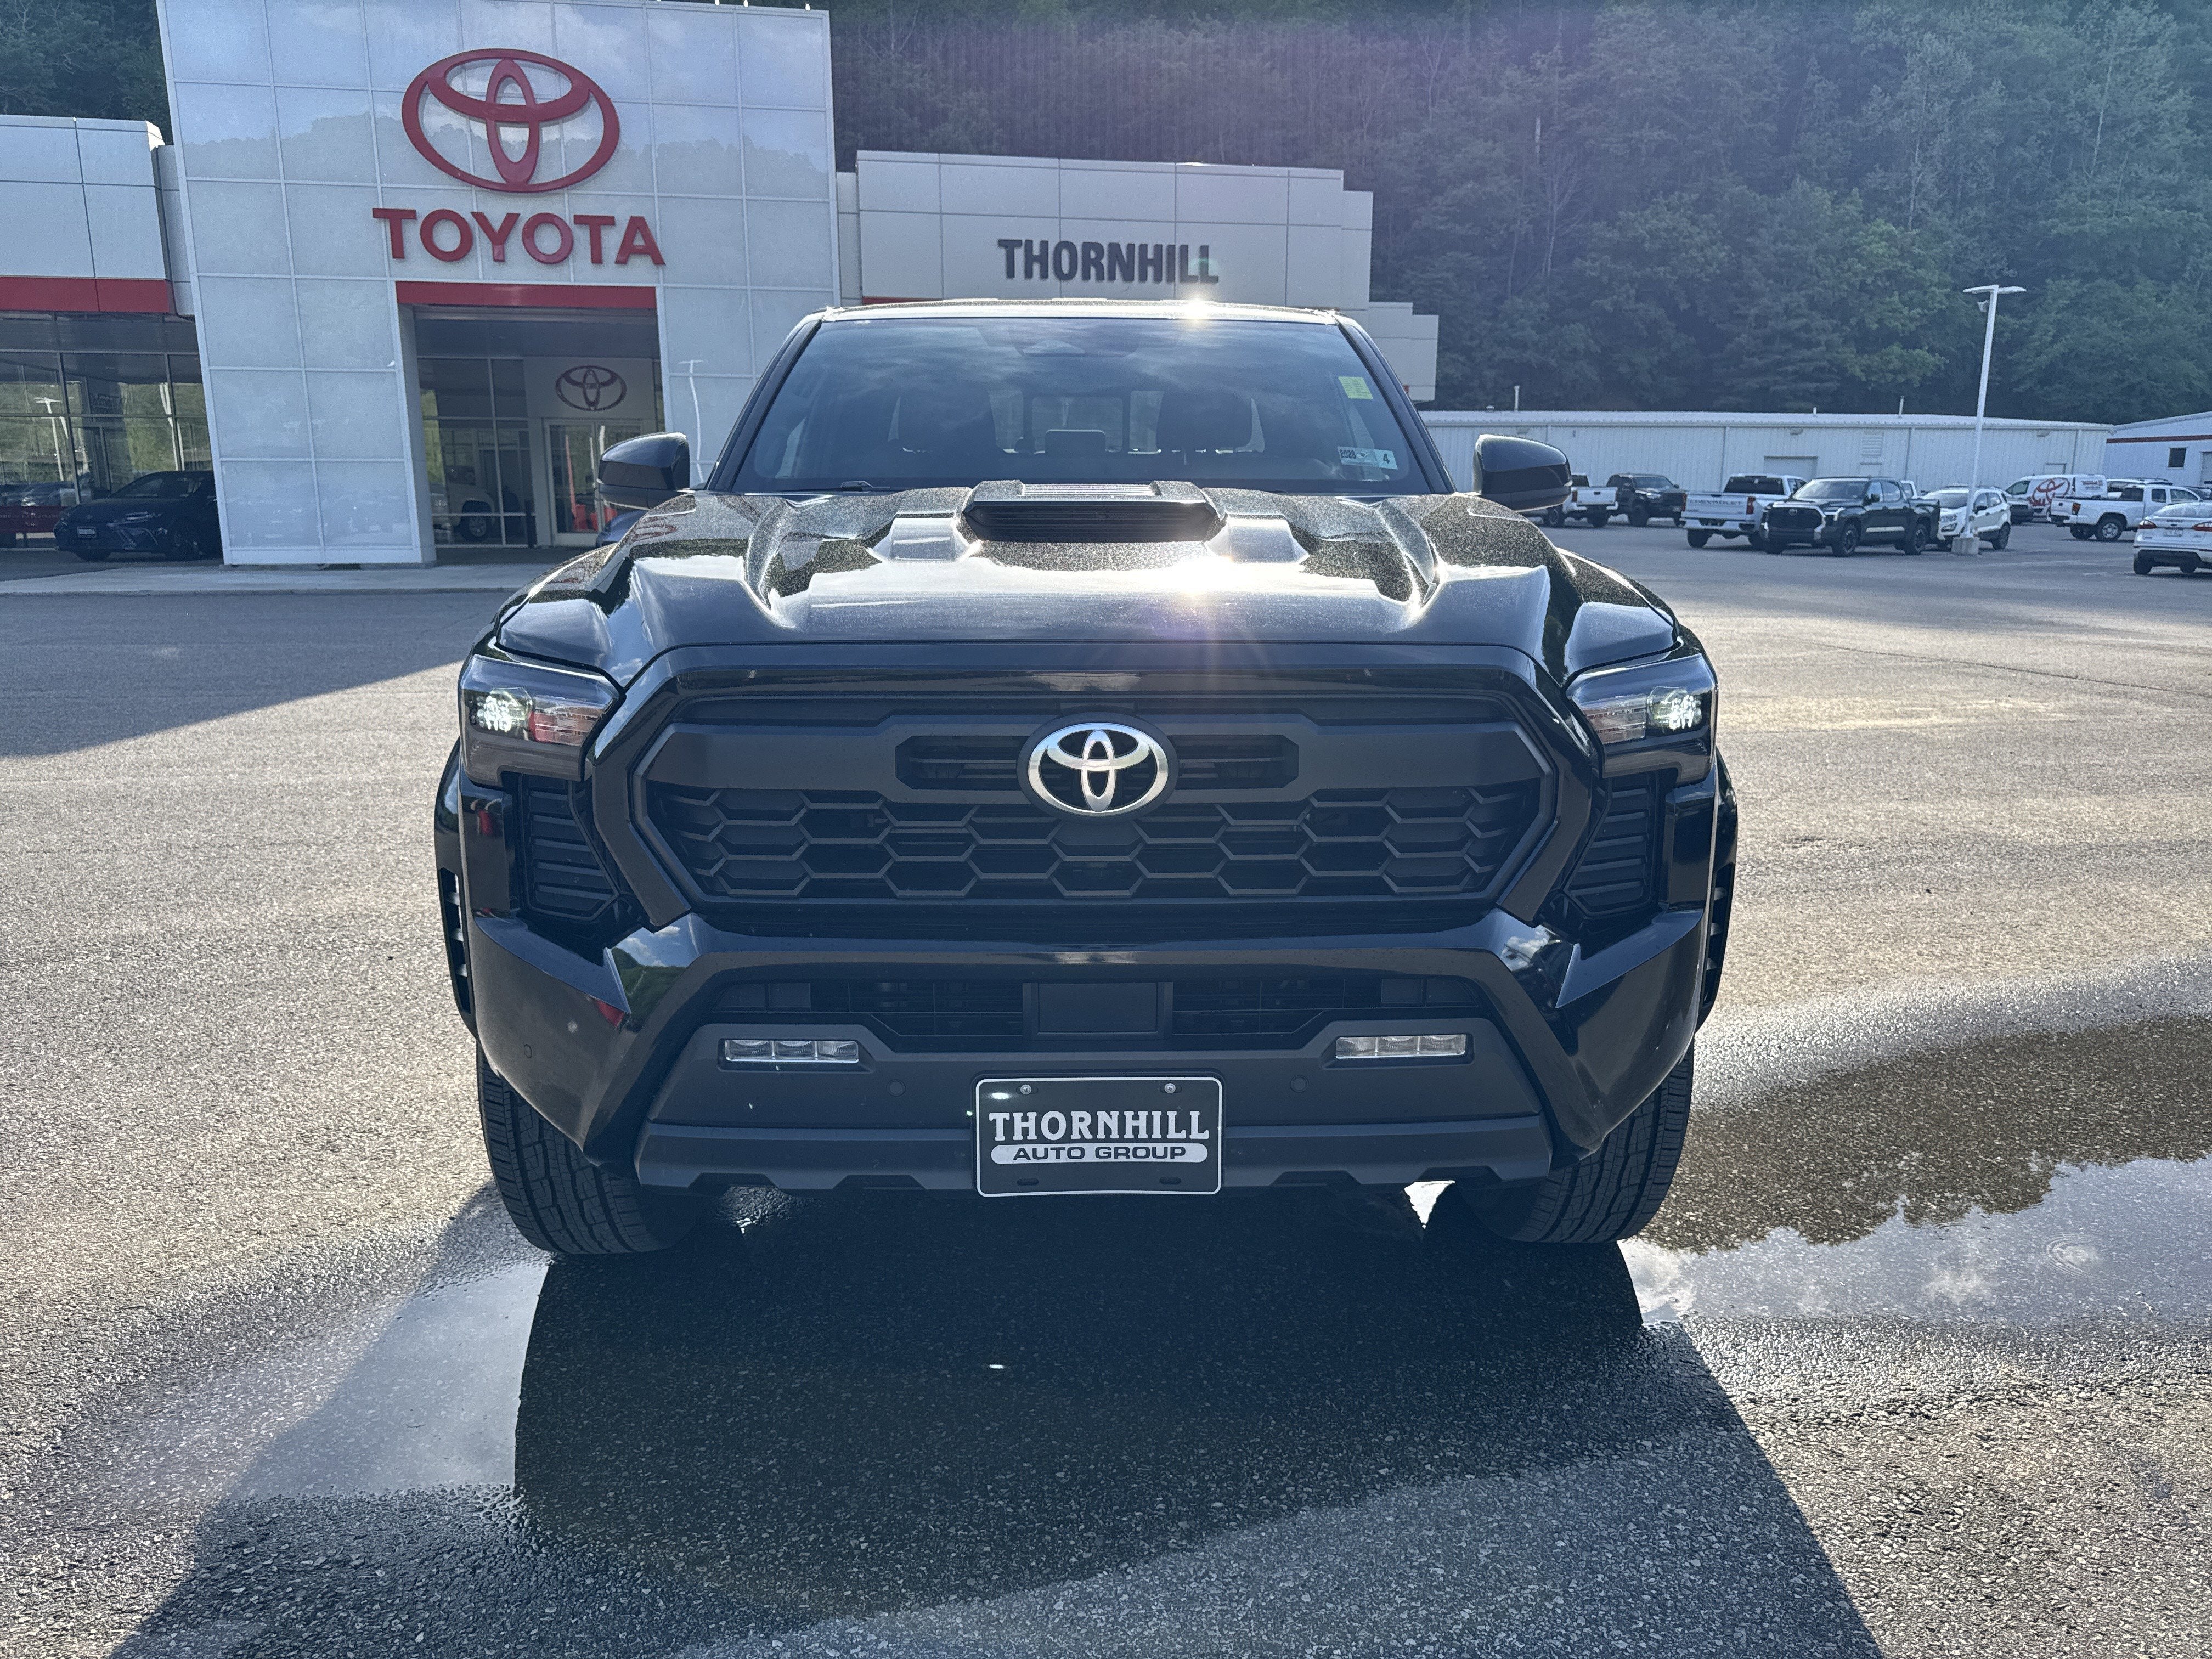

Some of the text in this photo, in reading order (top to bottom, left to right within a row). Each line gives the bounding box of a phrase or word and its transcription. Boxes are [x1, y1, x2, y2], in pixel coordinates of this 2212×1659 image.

[372, 207, 665, 266] TOYOTA
[998, 239, 1219, 284] THORNHILL
[1383, 453, 1390, 464] 4
[989, 1110, 1209, 1141] THORNHILL
[1012, 1146, 1186, 1160] AUTO GROUP
